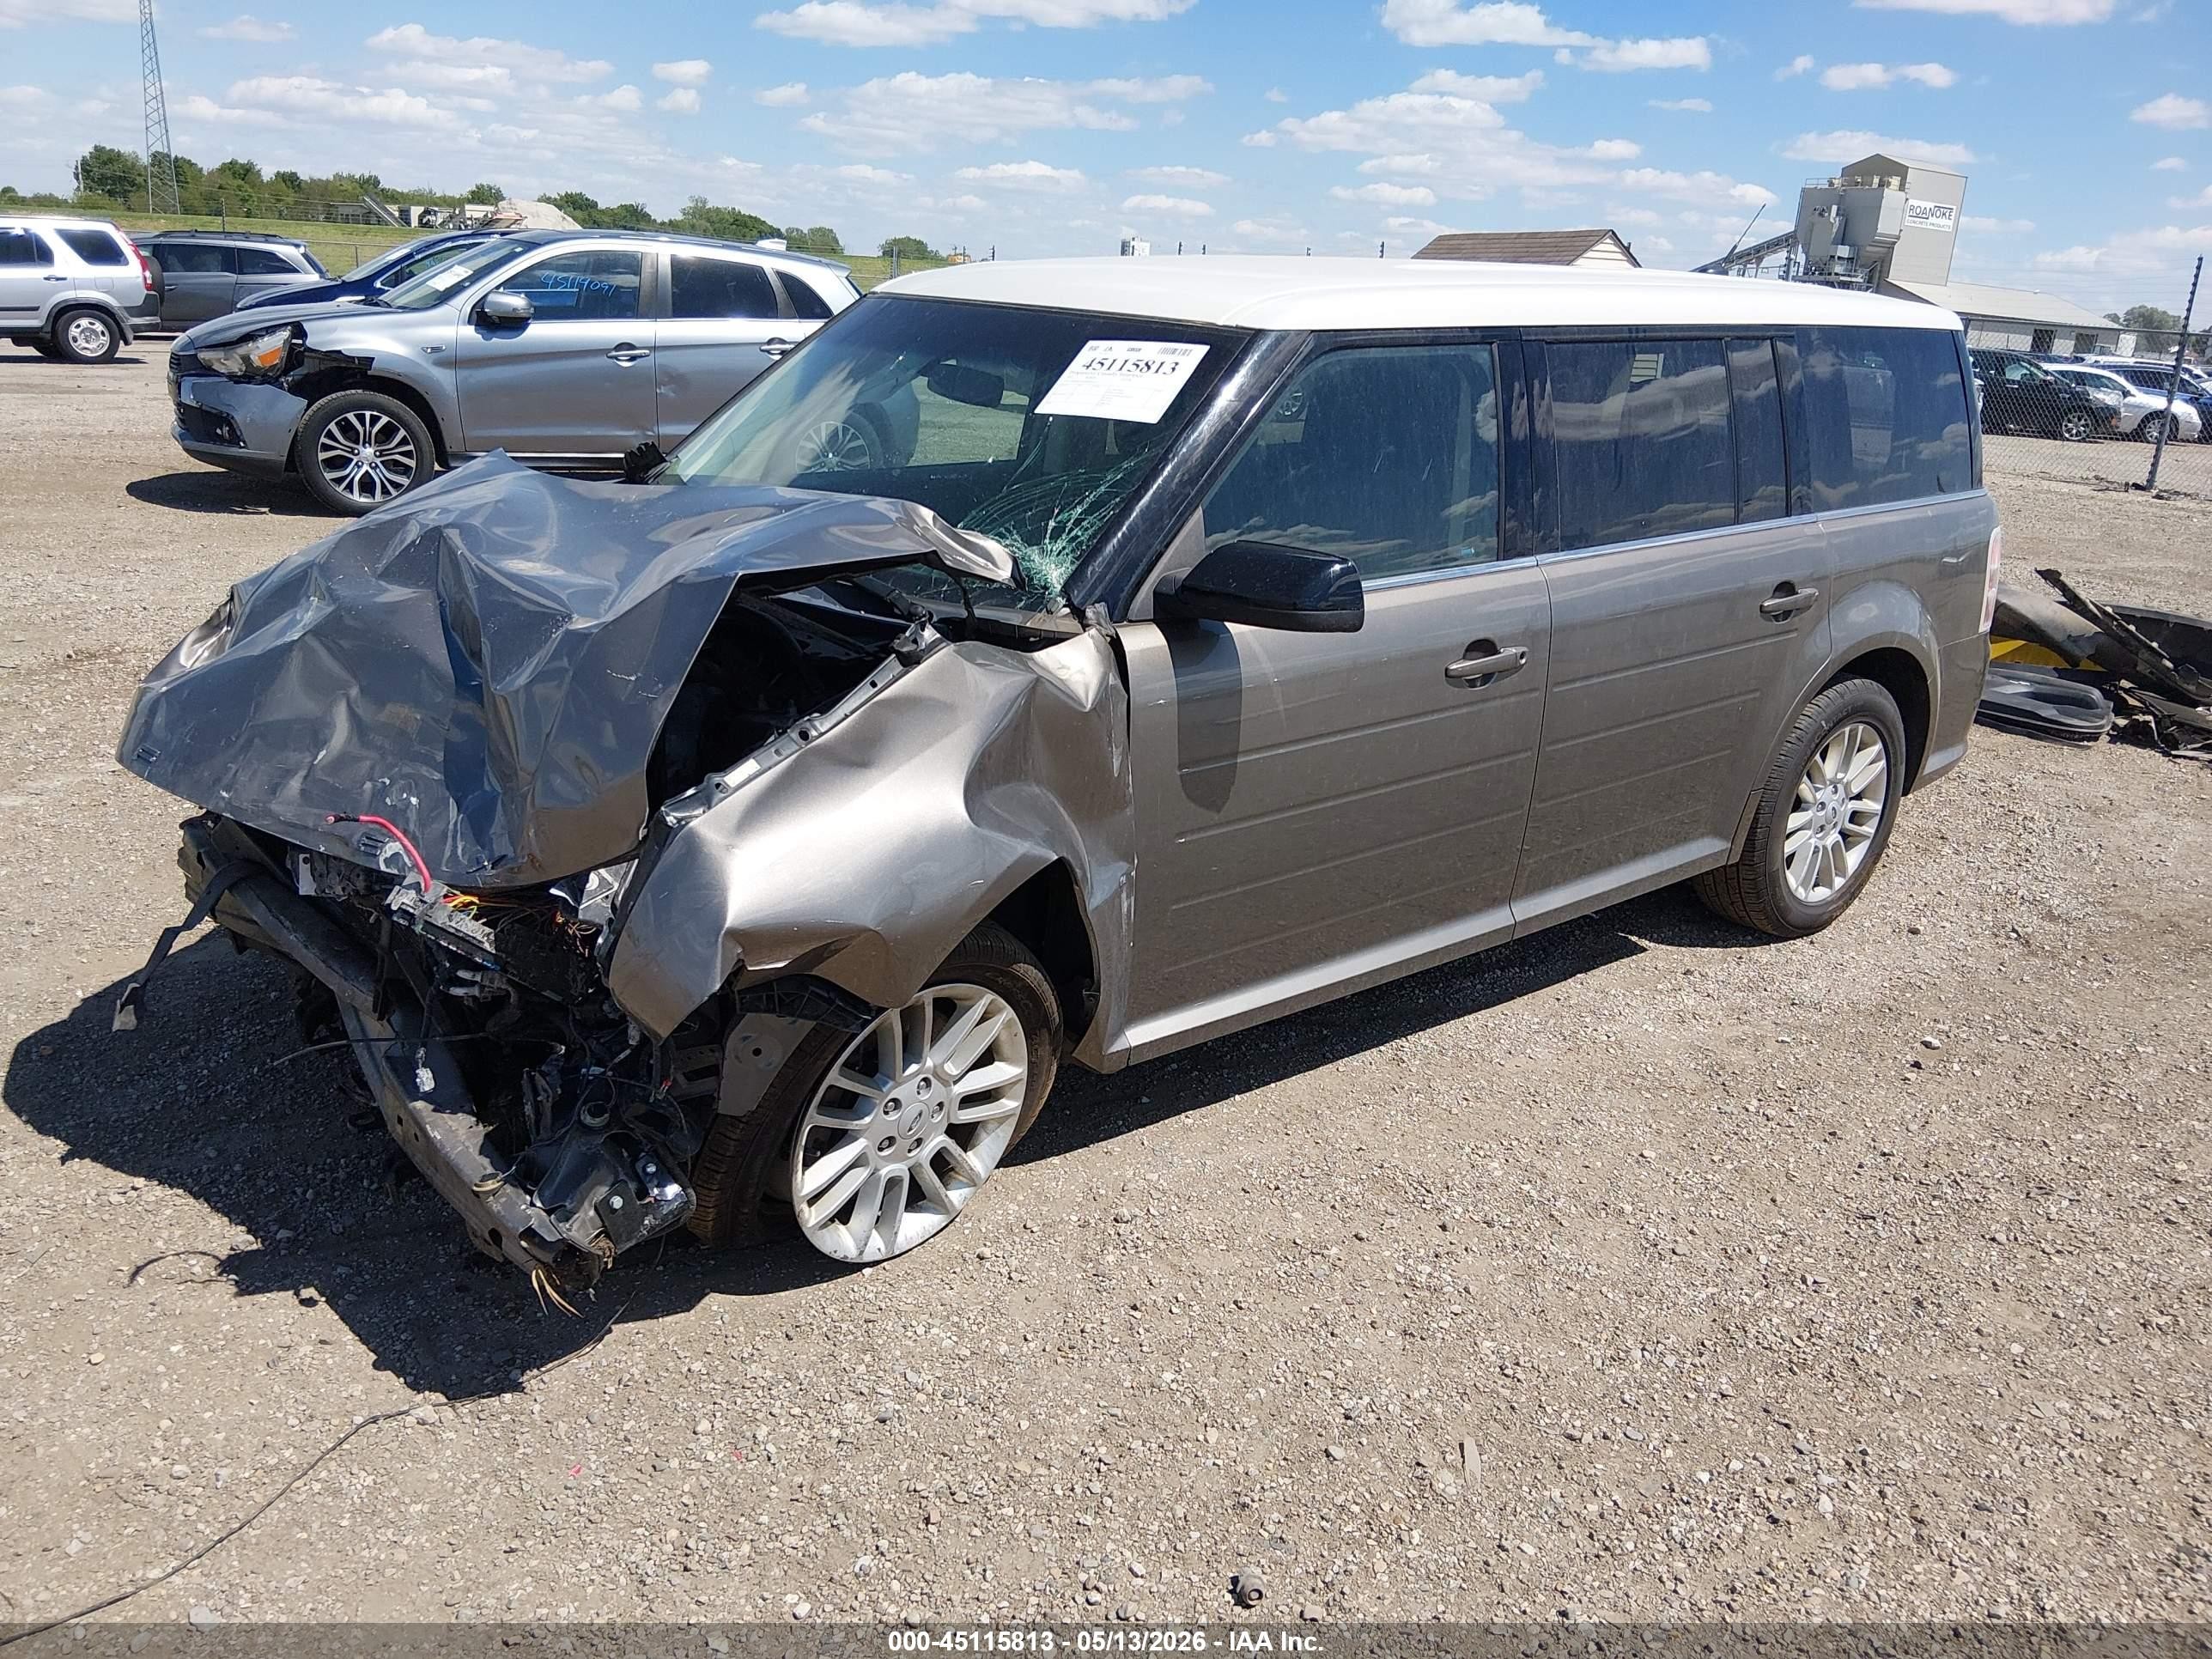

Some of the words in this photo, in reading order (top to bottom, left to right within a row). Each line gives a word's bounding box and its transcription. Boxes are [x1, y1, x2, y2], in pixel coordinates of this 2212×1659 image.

[1908, 204, 1954, 221] ROANOKE
[1929, 222, 1952, 230] PRODUCTS
[541, 271, 617, 297] 45114091
[1081, 356, 1181, 375] 45115813
